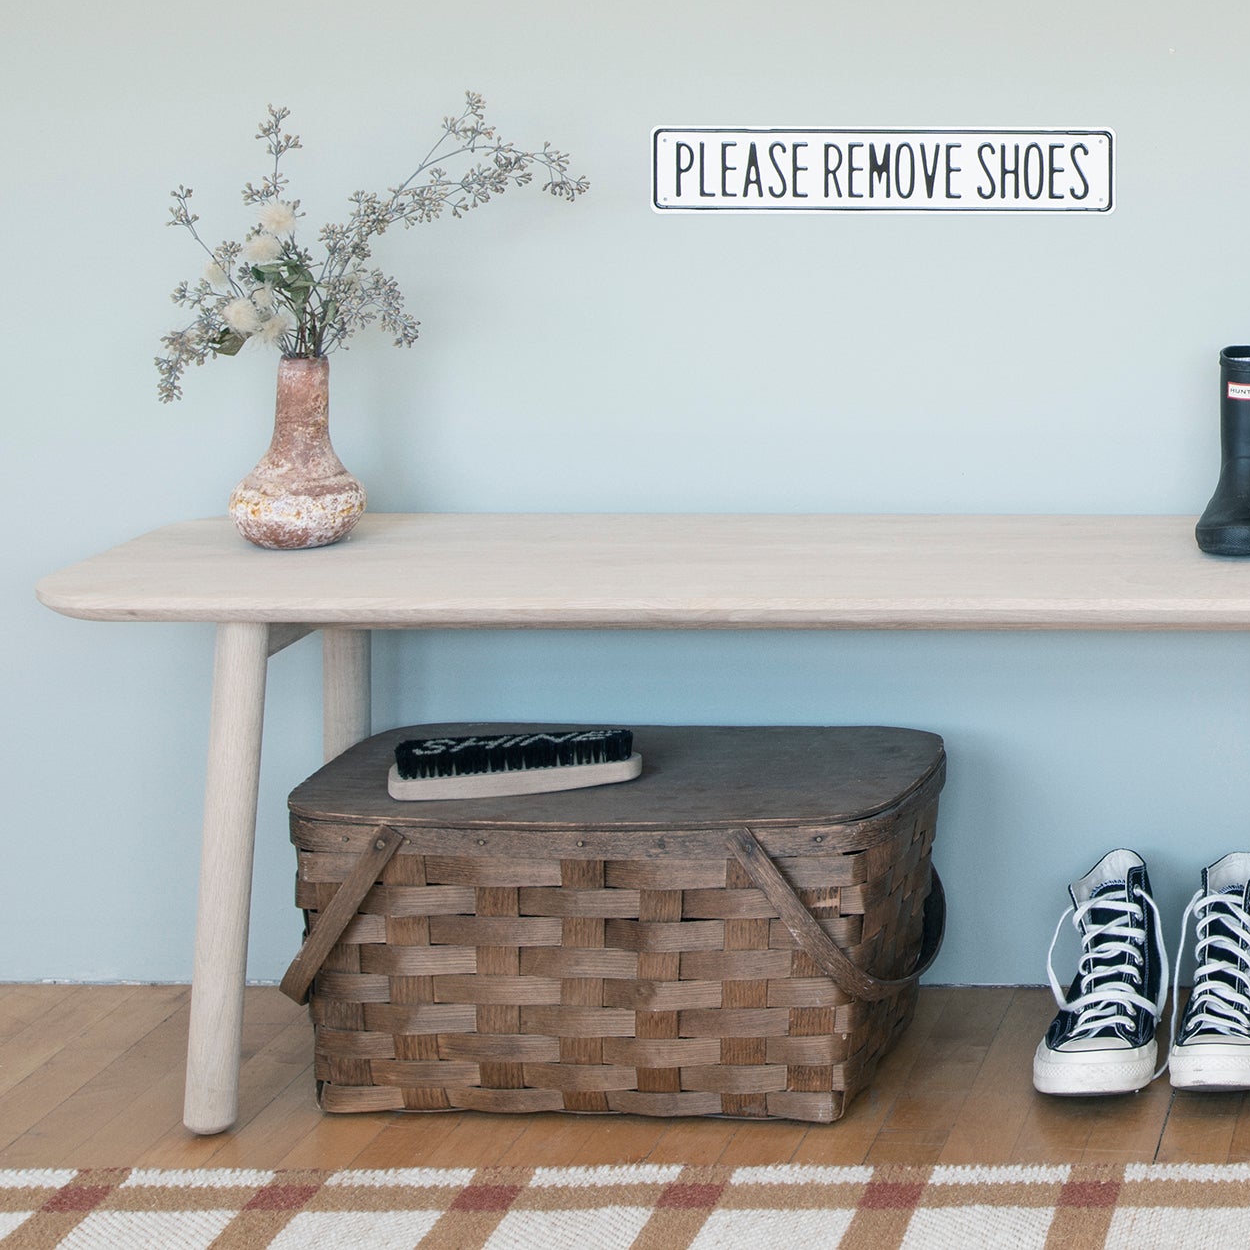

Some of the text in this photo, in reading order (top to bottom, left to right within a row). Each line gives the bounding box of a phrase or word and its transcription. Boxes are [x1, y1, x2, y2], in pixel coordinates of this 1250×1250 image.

[675, 141, 1090, 200] PLEASE REMOVE SHOES
[412, 729, 622, 755] SHINE
